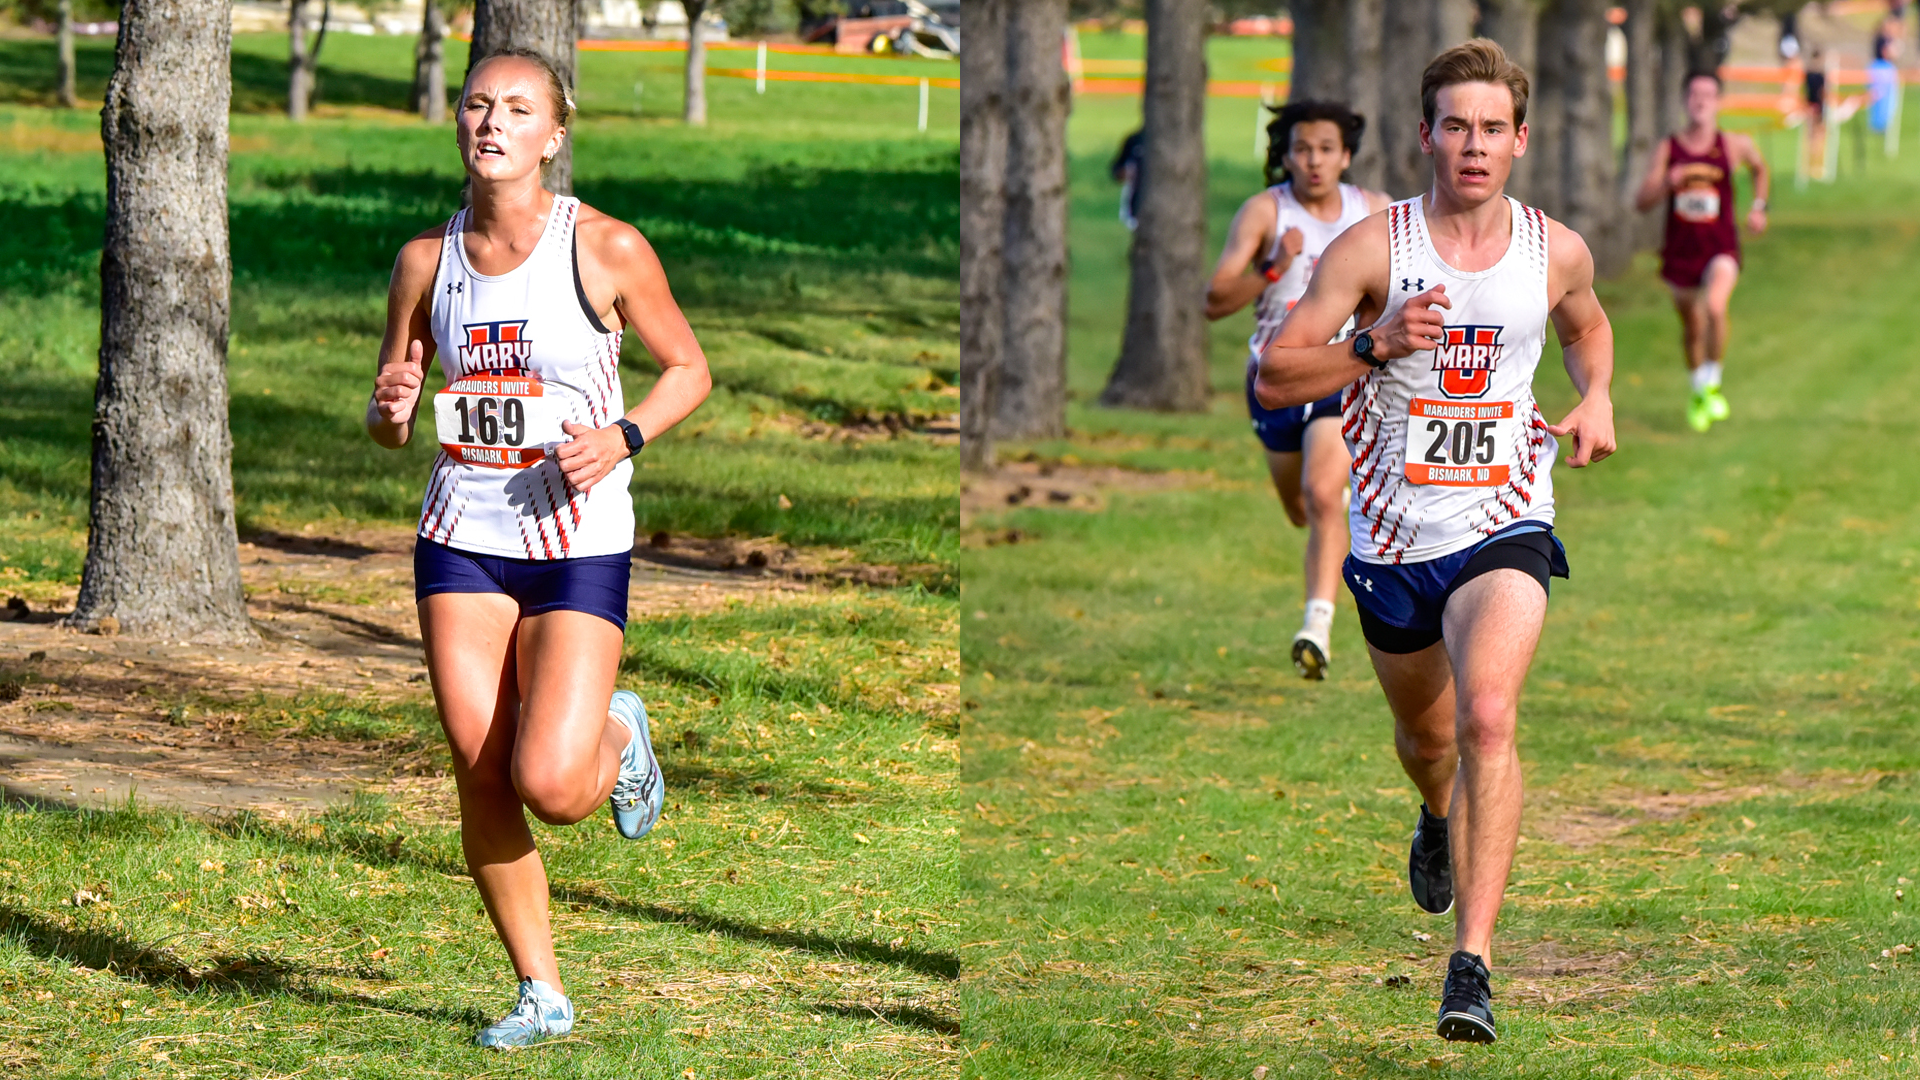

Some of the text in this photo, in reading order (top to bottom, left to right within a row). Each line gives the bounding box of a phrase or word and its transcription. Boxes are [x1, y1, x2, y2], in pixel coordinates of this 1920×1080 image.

[458, 340, 533, 377] MARY
[1431, 343, 1504, 372] MARY
[449, 380, 530, 395] MARAUDERS INVITE
[454, 396, 525, 447] 169
[1423, 403, 1503, 418] MARAUDERS INVITE
[1424, 419, 1497, 466] 205
[461, 447, 522, 465] BISMARK, ND
[1428, 467, 1490, 483] BISMARK, ND
